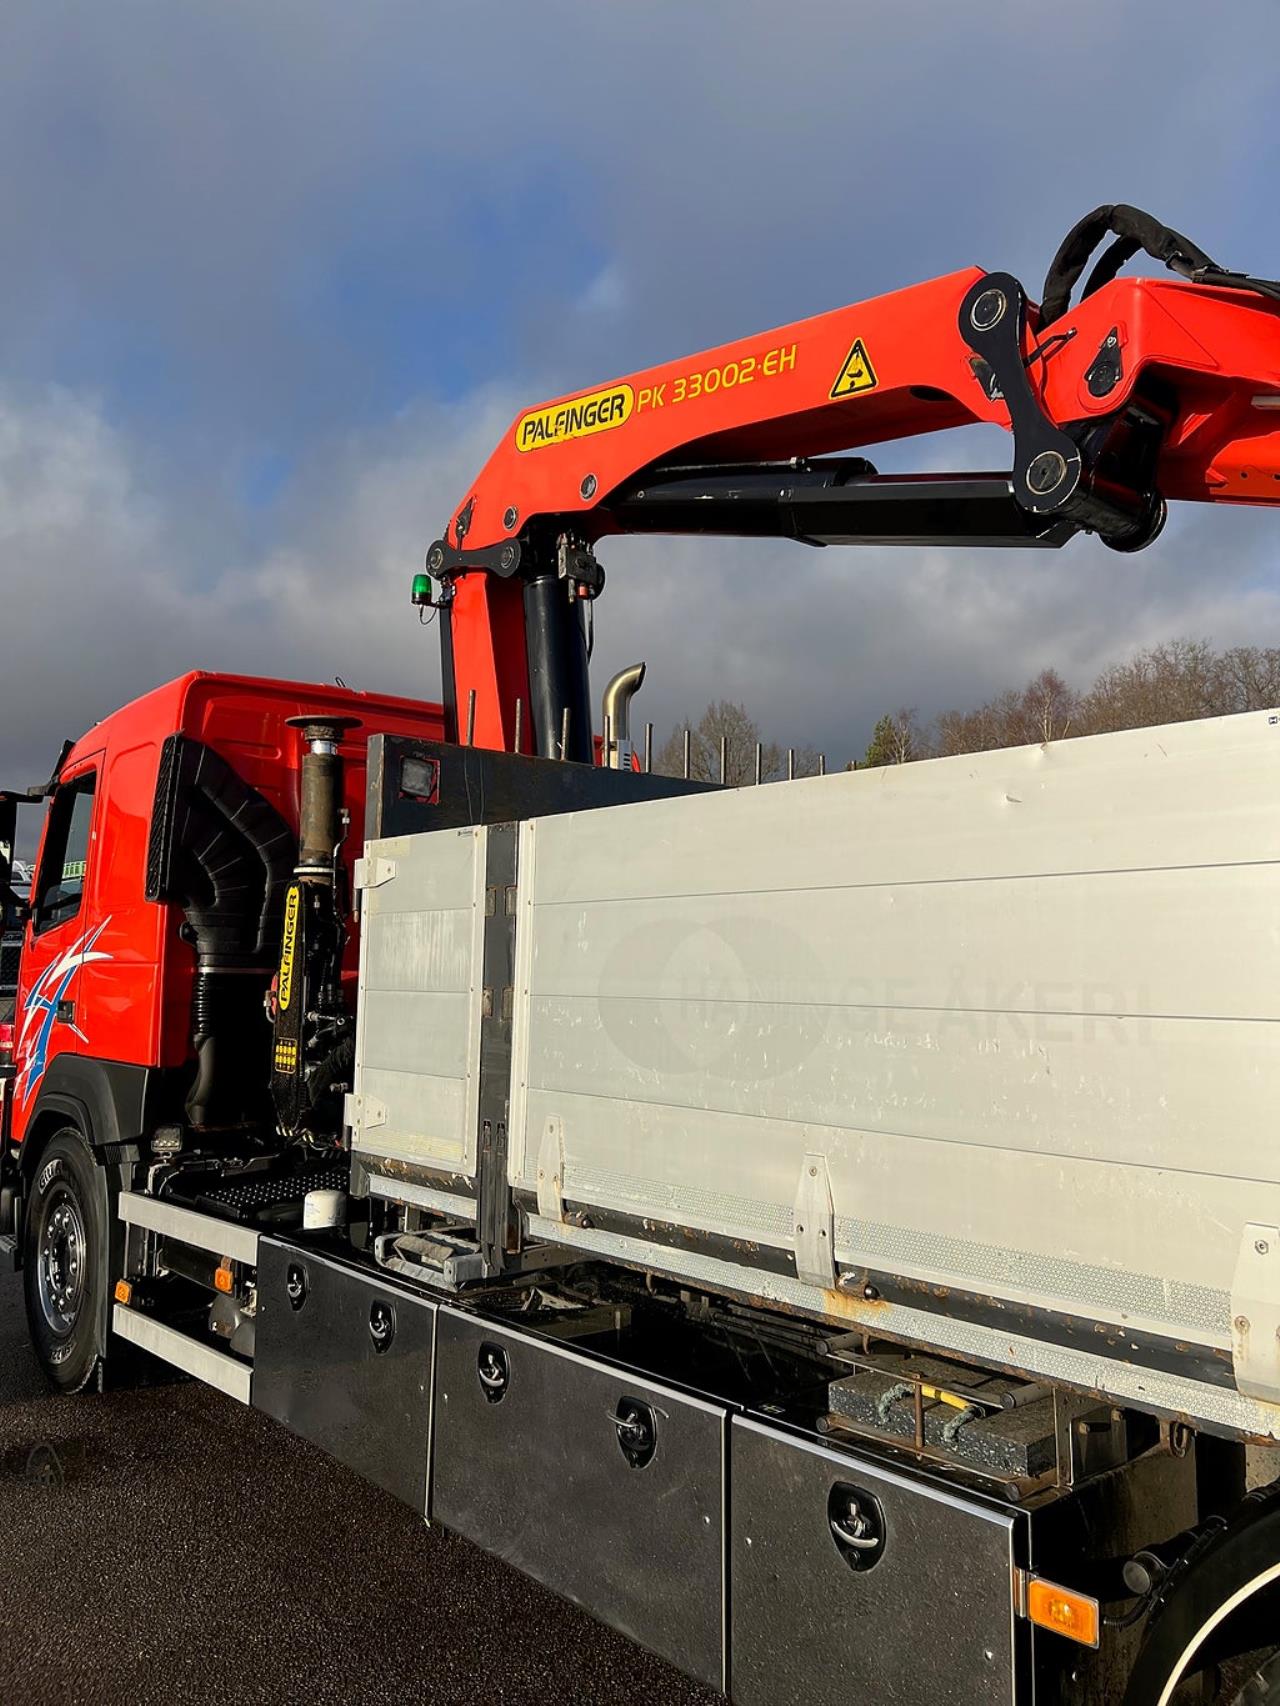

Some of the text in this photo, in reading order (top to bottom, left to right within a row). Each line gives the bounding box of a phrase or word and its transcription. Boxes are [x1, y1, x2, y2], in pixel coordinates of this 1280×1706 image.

[522, 394, 625, 445] PALFINGER
[637, 384, 666, 412] PK
[281, 894, 296, 1001] PALFINGER
[937, 962, 1152, 1046] ÅKERI
